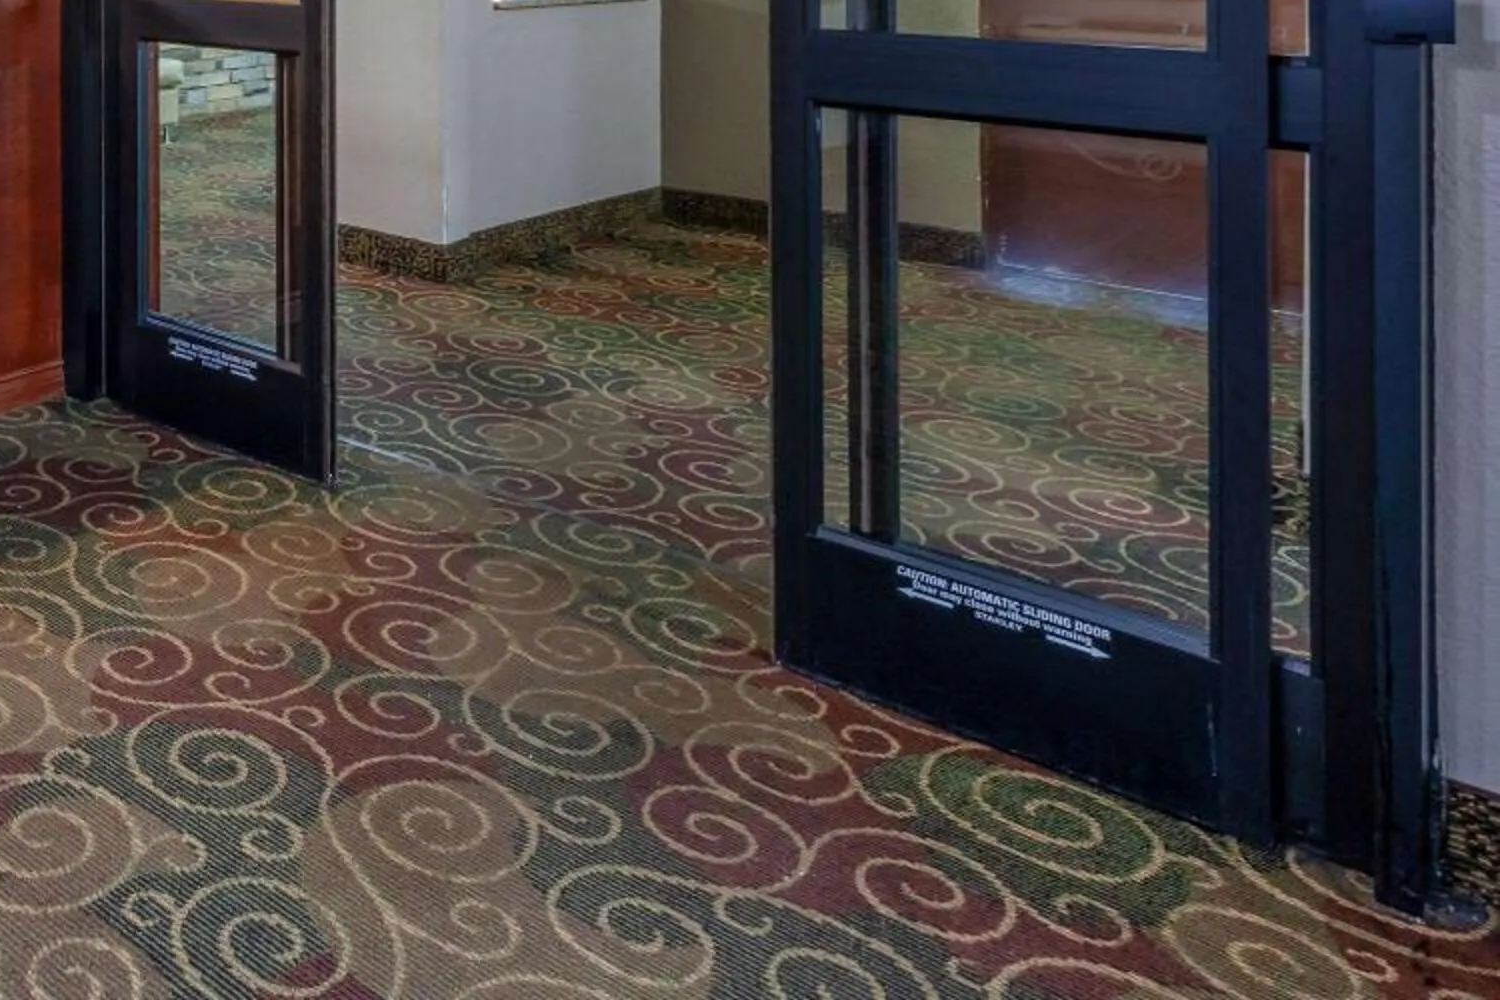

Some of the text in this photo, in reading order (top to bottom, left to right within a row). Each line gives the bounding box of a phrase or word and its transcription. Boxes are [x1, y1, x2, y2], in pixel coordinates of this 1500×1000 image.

[897, 565, 1111, 641] CAUTION AUTOMATIC SLIDING DOOR
[912, 580, 1093, 647] Door may close without warning
[975, 610, 1023, 632] STANLEY
